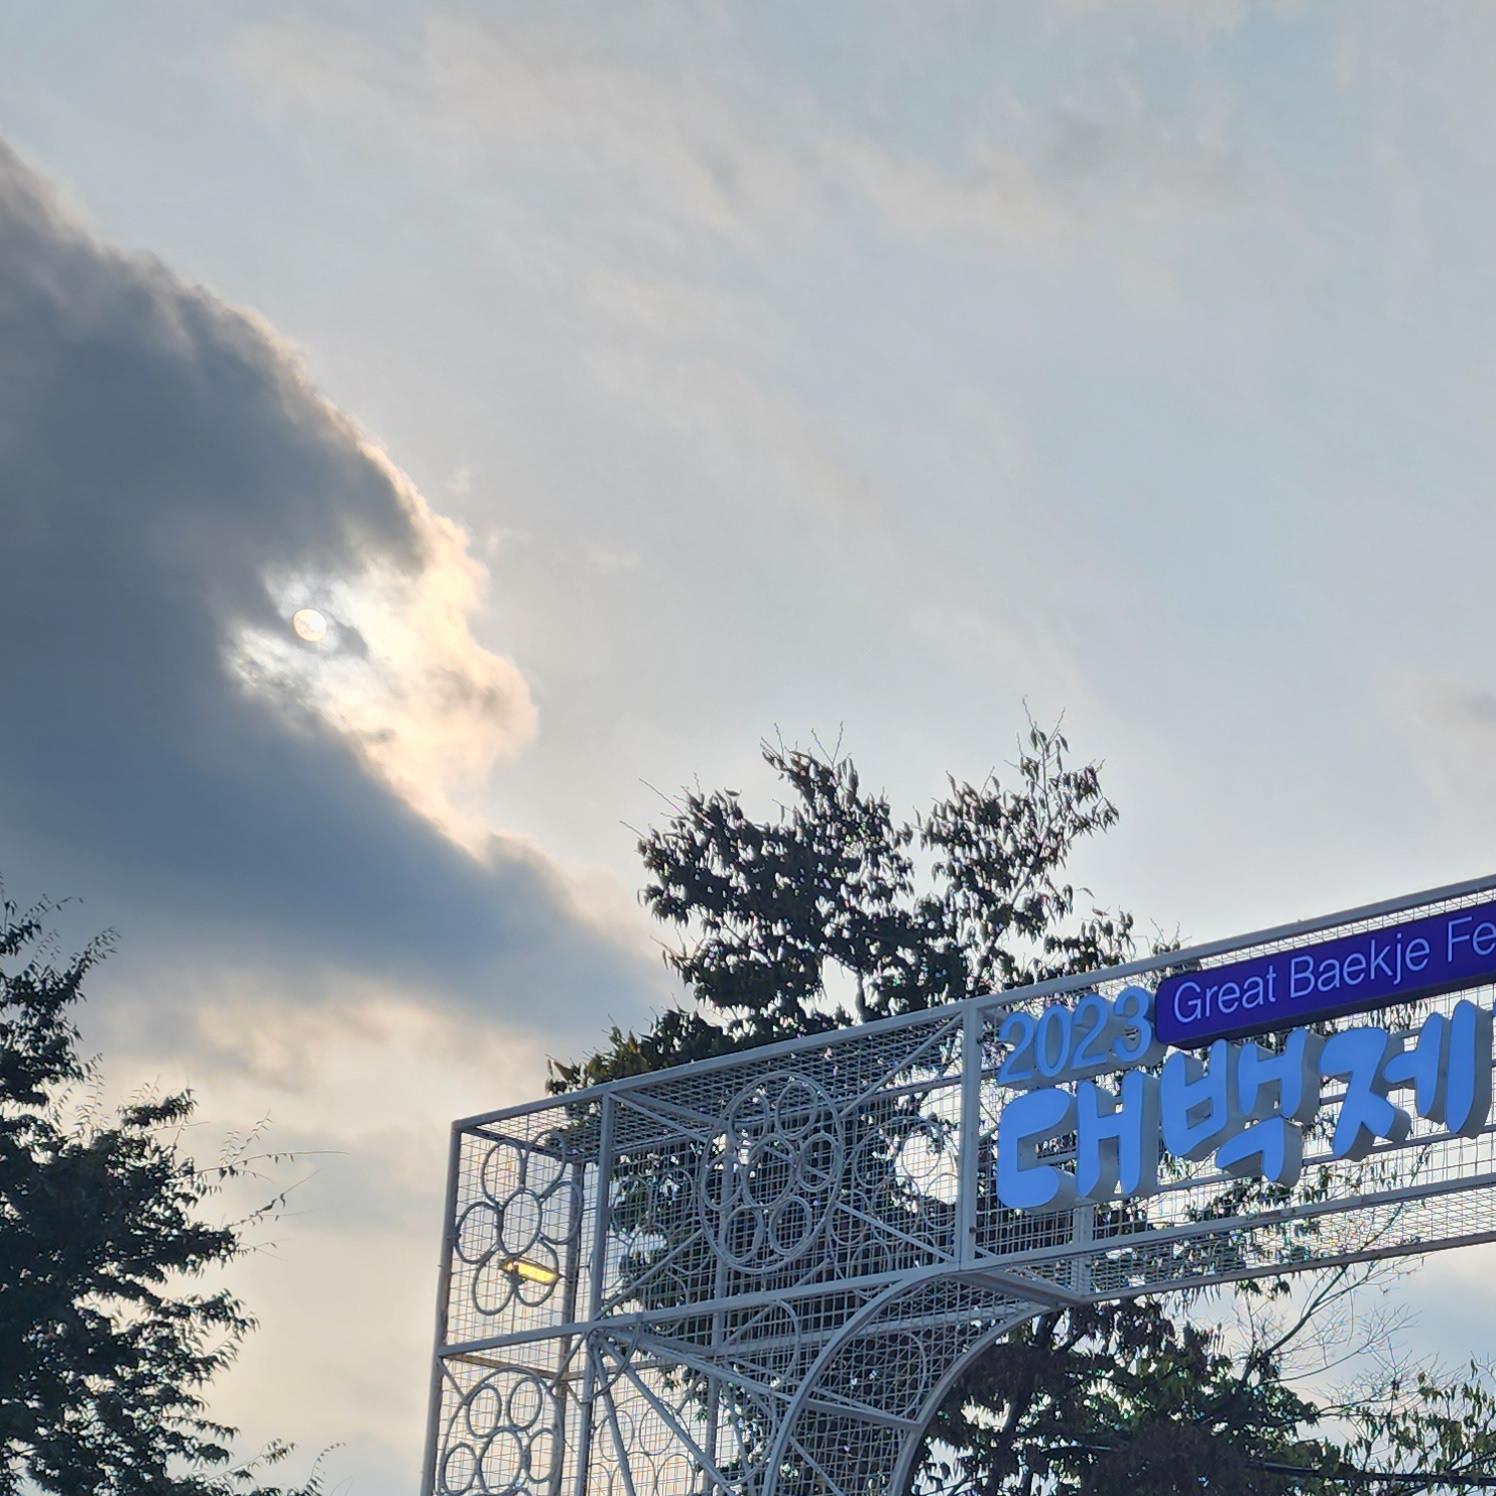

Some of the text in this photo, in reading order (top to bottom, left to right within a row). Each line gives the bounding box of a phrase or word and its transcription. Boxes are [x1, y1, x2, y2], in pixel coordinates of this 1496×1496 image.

[998, 985, 1160, 1084] 2023
[1172, 974, 1277, 1026] Great
[1289, 932, 1430, 998] Baekje
